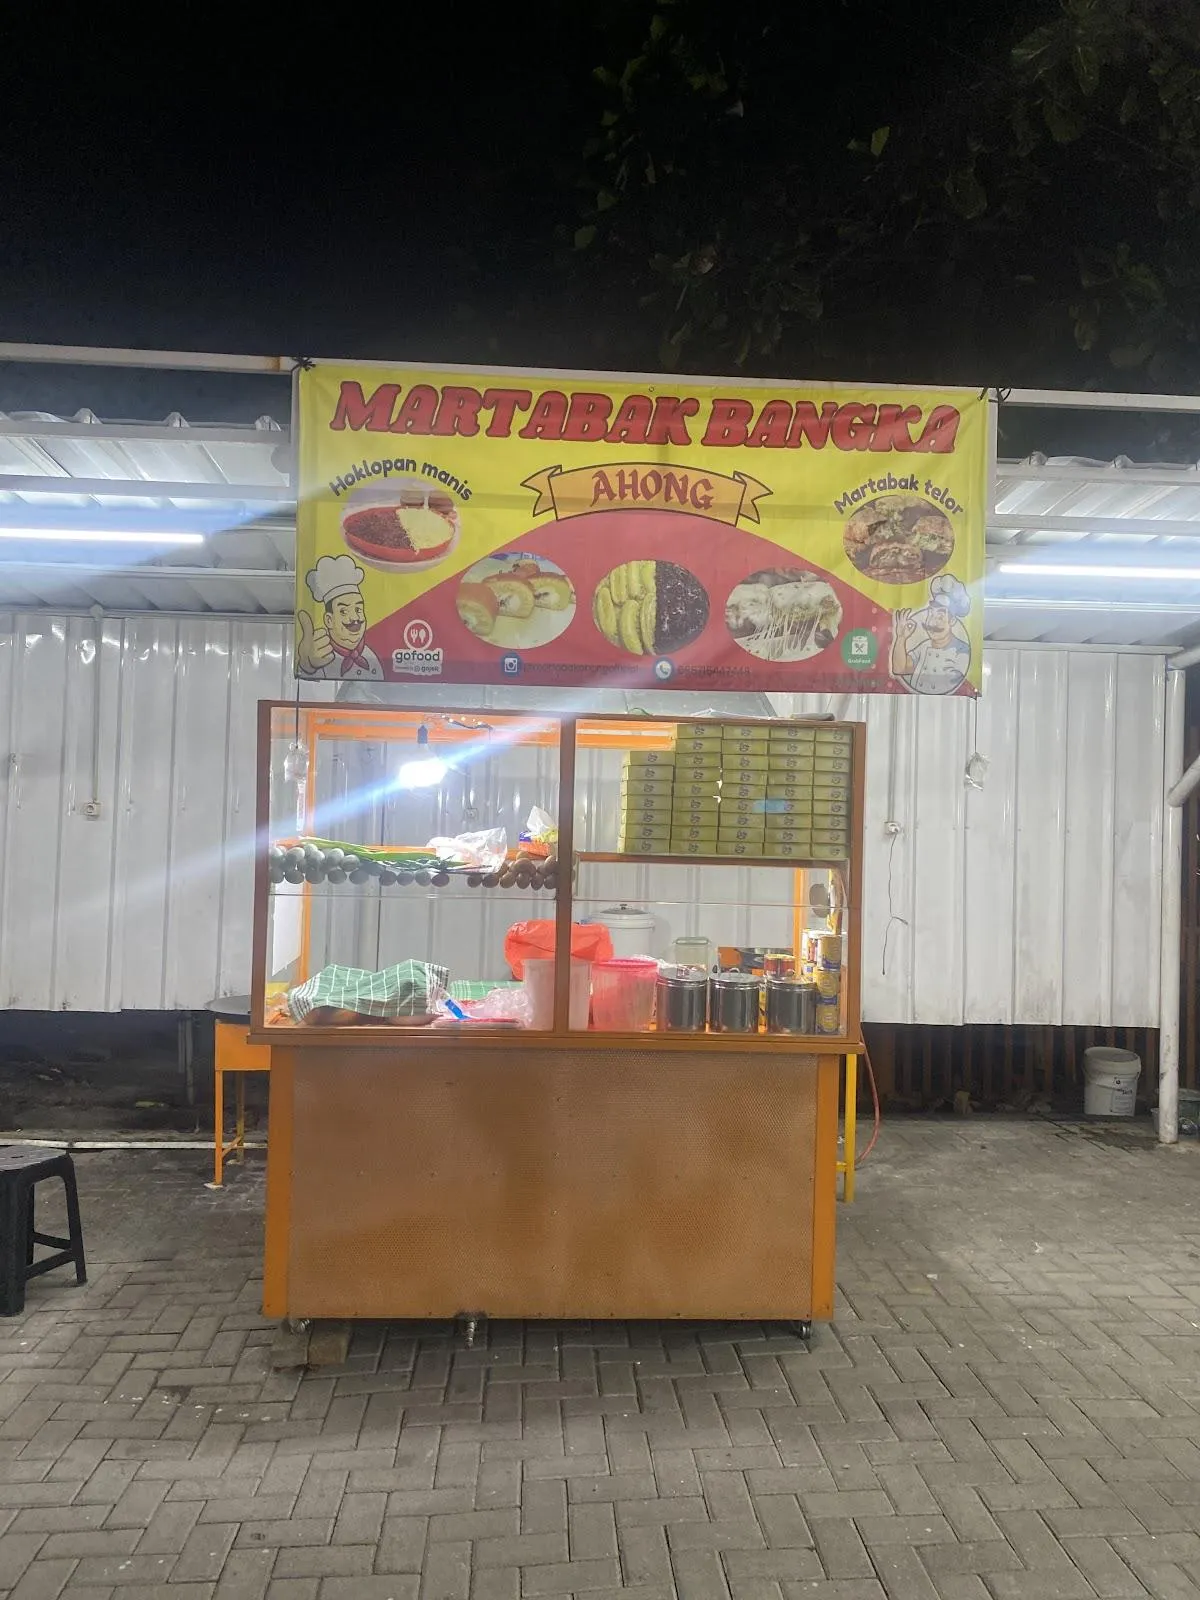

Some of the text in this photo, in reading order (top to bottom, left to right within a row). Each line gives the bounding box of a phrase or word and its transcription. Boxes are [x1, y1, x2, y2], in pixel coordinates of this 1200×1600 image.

[329, 381, 961, 454] MARTABAK BANGKA
[329, 457, 473, 501] Hoklopan manis
[590, 469, 714, 510] AHONG
[833, 472, 964, 515] Martabak telor
[395, 650, 440, 663] gofood
